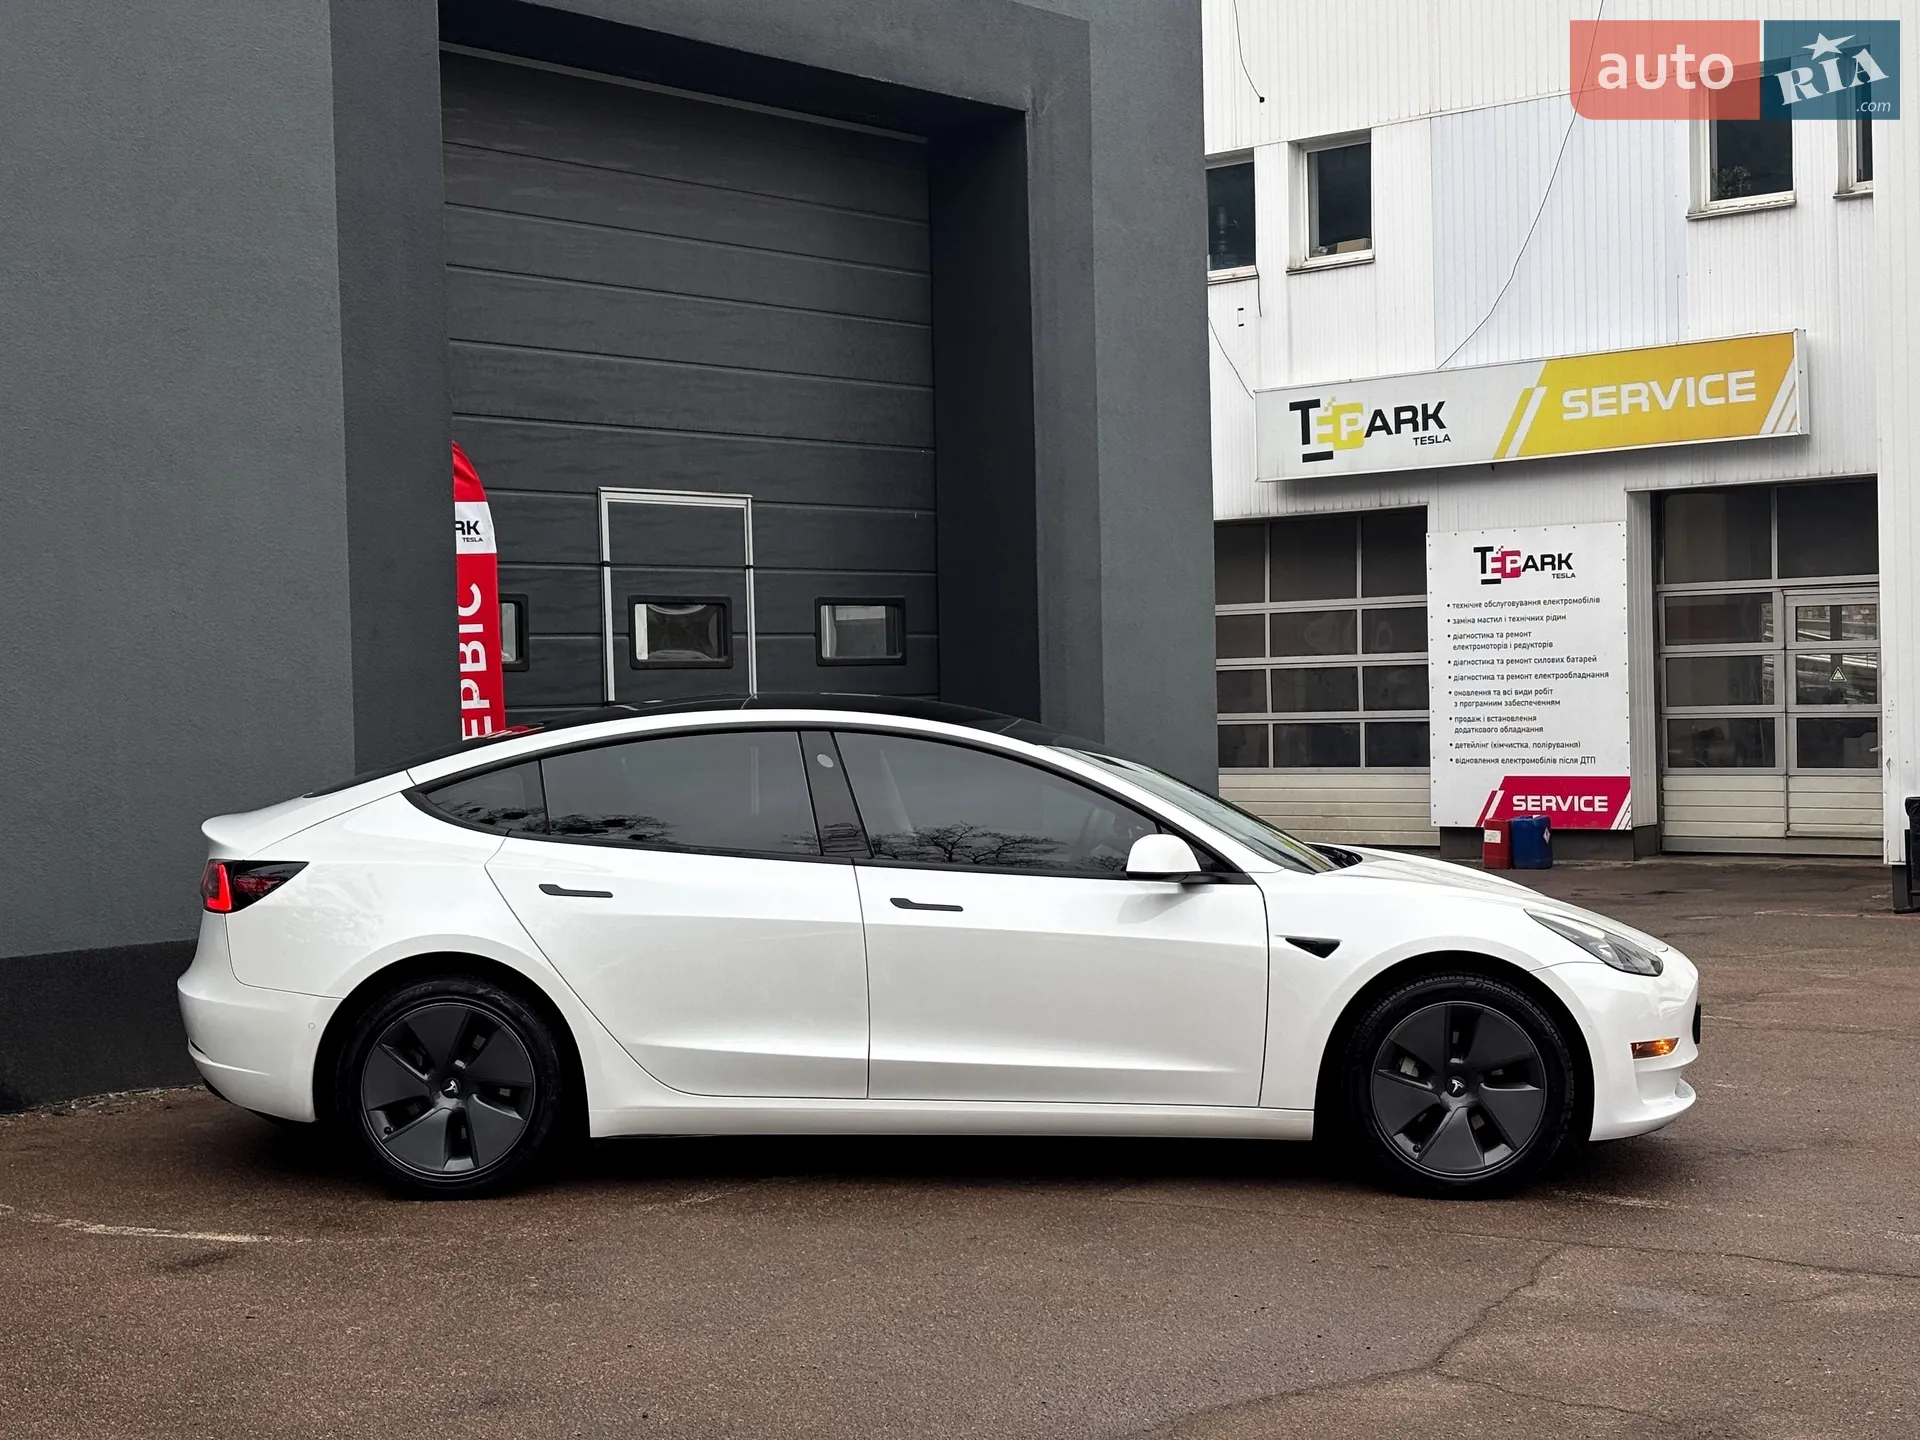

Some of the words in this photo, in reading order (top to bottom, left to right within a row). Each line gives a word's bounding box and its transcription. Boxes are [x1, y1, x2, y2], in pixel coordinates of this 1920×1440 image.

[1562, 369, 1756, 421] SERVICE
[1412, 433, 1451, 447] TESLA
[1552, 572, 1576, 580] TESLA
[1484, 599, 1541, 609] обслуговування
[1543, 596, 1601, 605] електромобілів
[1545, 614, 1566, 622] рідин
[1453, 632, 1494, 640] діагностика
[1506, 631, 1532, 640] ремонт
[1453, 643, 1508, 651] електромоторів
[1514, 640, 1553, 650] редукторів
[1506, 658, 1532, 666] ремонт
[1567, 655, 1597, 664] батарей
[1453, 674, 1495, 682] діагностика
[1534, 671, 1609, 680] електрообладнання
[1534, 688, 1553, 696] робіт
[1459, 700, 1502, 708] програмним
[1504, 699, 1560, 707] забеспеченням
[1454, 716, 1481, 724] продаж
[1533, 741, 1581, 749] полірування)
[1580, 756, 1596, 765] ДТП
[1512, 795, 1608, 812] SERVICE
